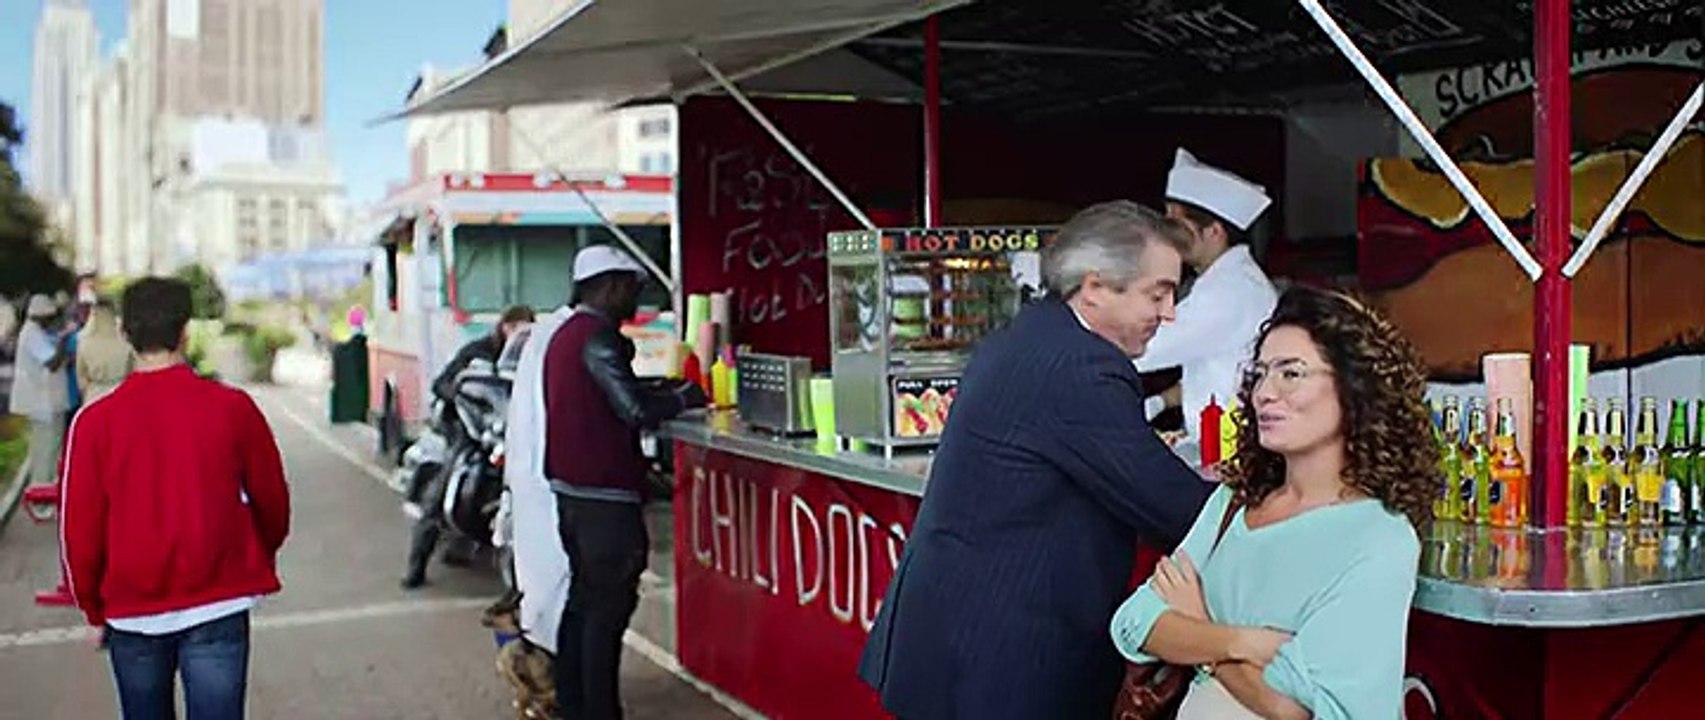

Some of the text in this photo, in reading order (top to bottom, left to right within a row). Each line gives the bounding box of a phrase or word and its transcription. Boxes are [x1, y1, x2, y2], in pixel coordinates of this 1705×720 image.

[906, 234, 1039, 251] HOT DOGS
[692, 466, 780, 596] CHILI
